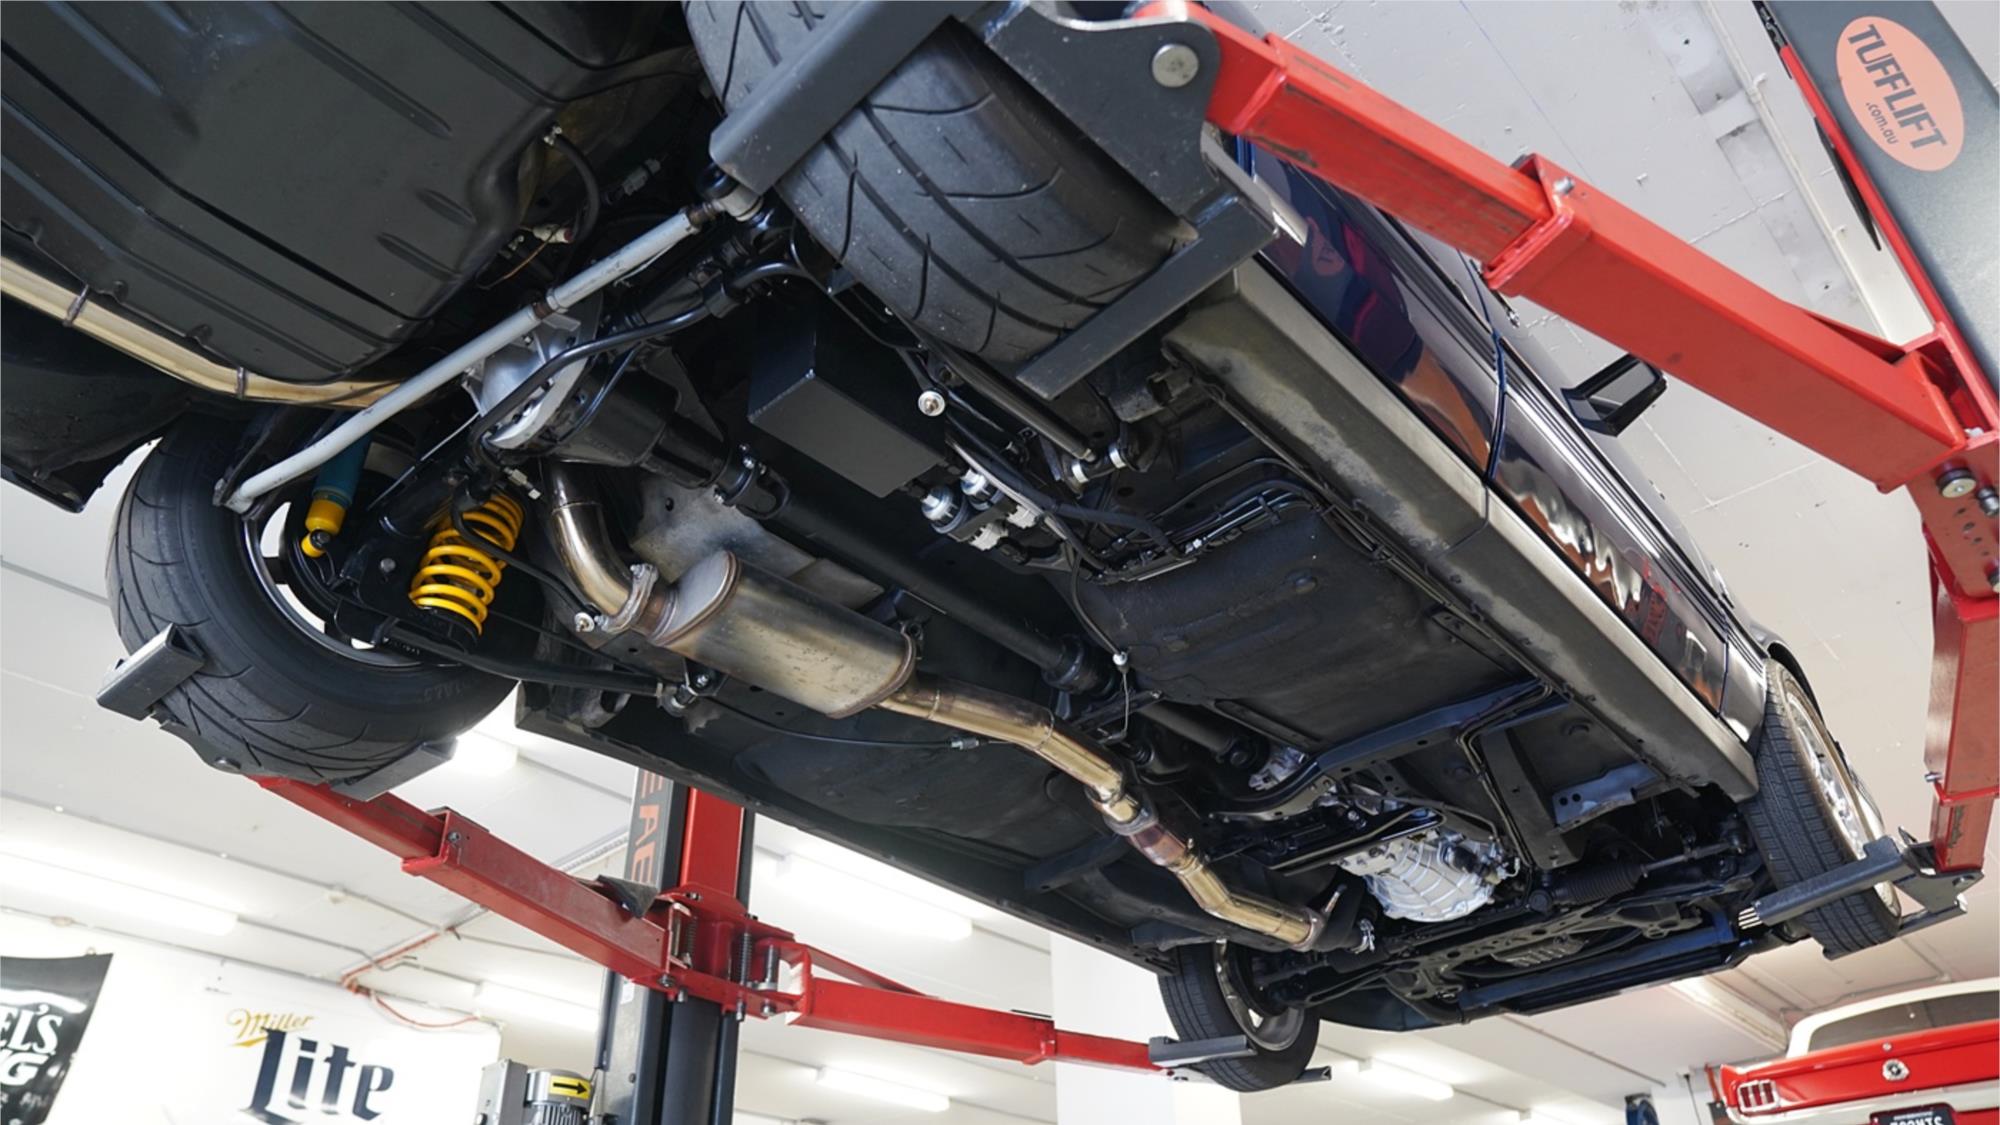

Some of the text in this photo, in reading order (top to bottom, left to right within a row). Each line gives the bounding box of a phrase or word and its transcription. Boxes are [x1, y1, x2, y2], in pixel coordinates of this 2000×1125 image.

[1848, 24, 1946, 149] TUFFLIFT
[1865, 102, 1900, 146] .com.au
[226, 1008, 314, 1038] Miller
[239, 1026, 395, 1125] Lite
